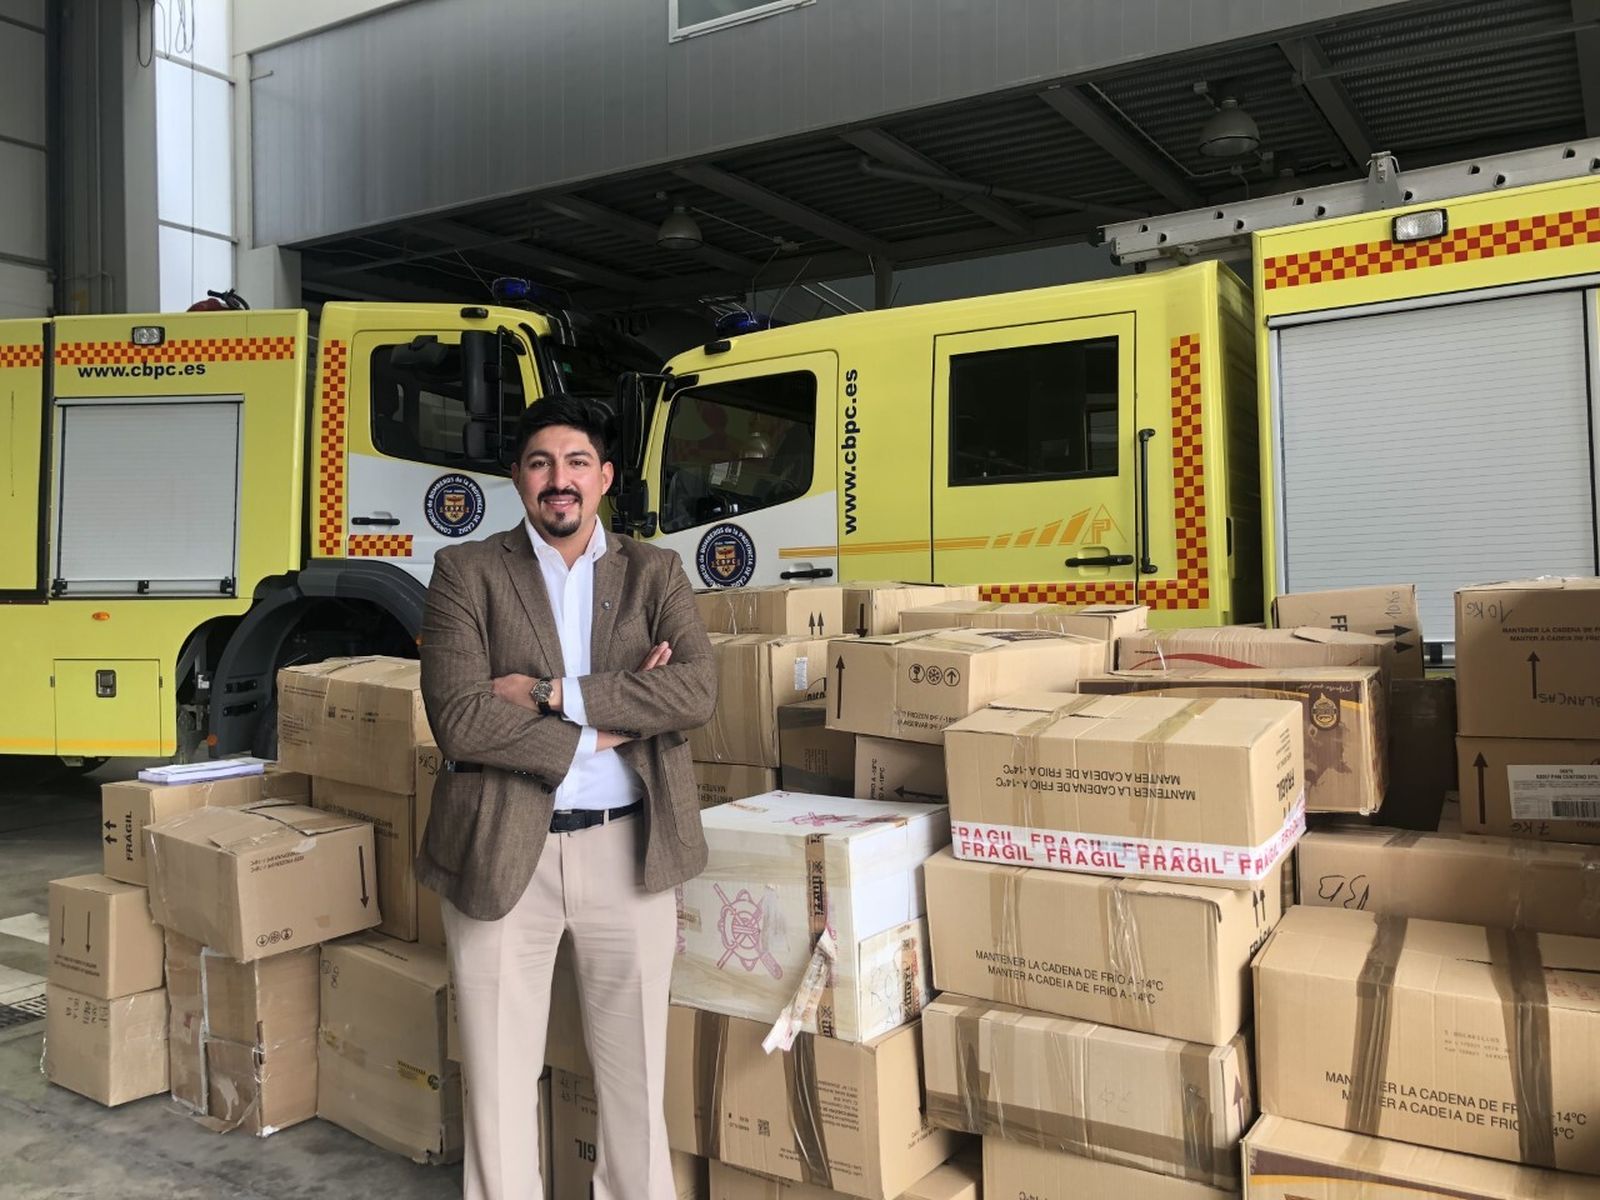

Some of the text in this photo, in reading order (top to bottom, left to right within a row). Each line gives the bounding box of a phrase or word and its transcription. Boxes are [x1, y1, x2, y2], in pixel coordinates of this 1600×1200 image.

[78, 361, 205, 380] www.cbpc.es
[840, 369, 860, 535] www.cbpc.es
[1029, 766, 1037, 777] A
[1038, 766, 1062, 778] FRIO
[1065, 768, 1080, 780] DE
[1082, 769, 1123, 782] CADEIA
[1124, 772, 1132, 782] A
[1022, 779, 1029, 789] A
[1135, 772, 1181, 785] MANTER
[1057, 781, 1071, 793] DE
[1074, 783, 1116, 796] CADENA
[1119, 785, 1133, 797] LA
[1134, 786, 1196, 801] MANTENER
[962, 841, 1034, 862] FRAGIL
[1047, 848, 1126, 869] FRAGIL
[1139, 853, 1224, 875] FRAGIL
[975, 949, 1026, 968] MANTENER
[1028, 960, 1041, 972] LA
[1041, 962, 1082, 979] CADENA
[1083, 970, 1098, 981] DE
[1127, 977, 1135, 986] A
[988, 965, 1026, 982] MANTER
[1028, 974, 1036, 982] A
[1036, 976, 1074, 990] CADEIA
[1076, 981, 1090, 993] DE
[1093, 984, 1118, 998] FRIO
[1119, 990, 1127, 1000] A
[1400, 1085, 1417, 1098] LA
[1420, 1088, 1475, 1109] CADENA
[1479, 1098, 1498, 1112] DE
[1398, 1099, 1408, 1110] A
[1410, 1103, 1462, 1121] CADEIA
[1466, 1112, 1485, 1126] DE
